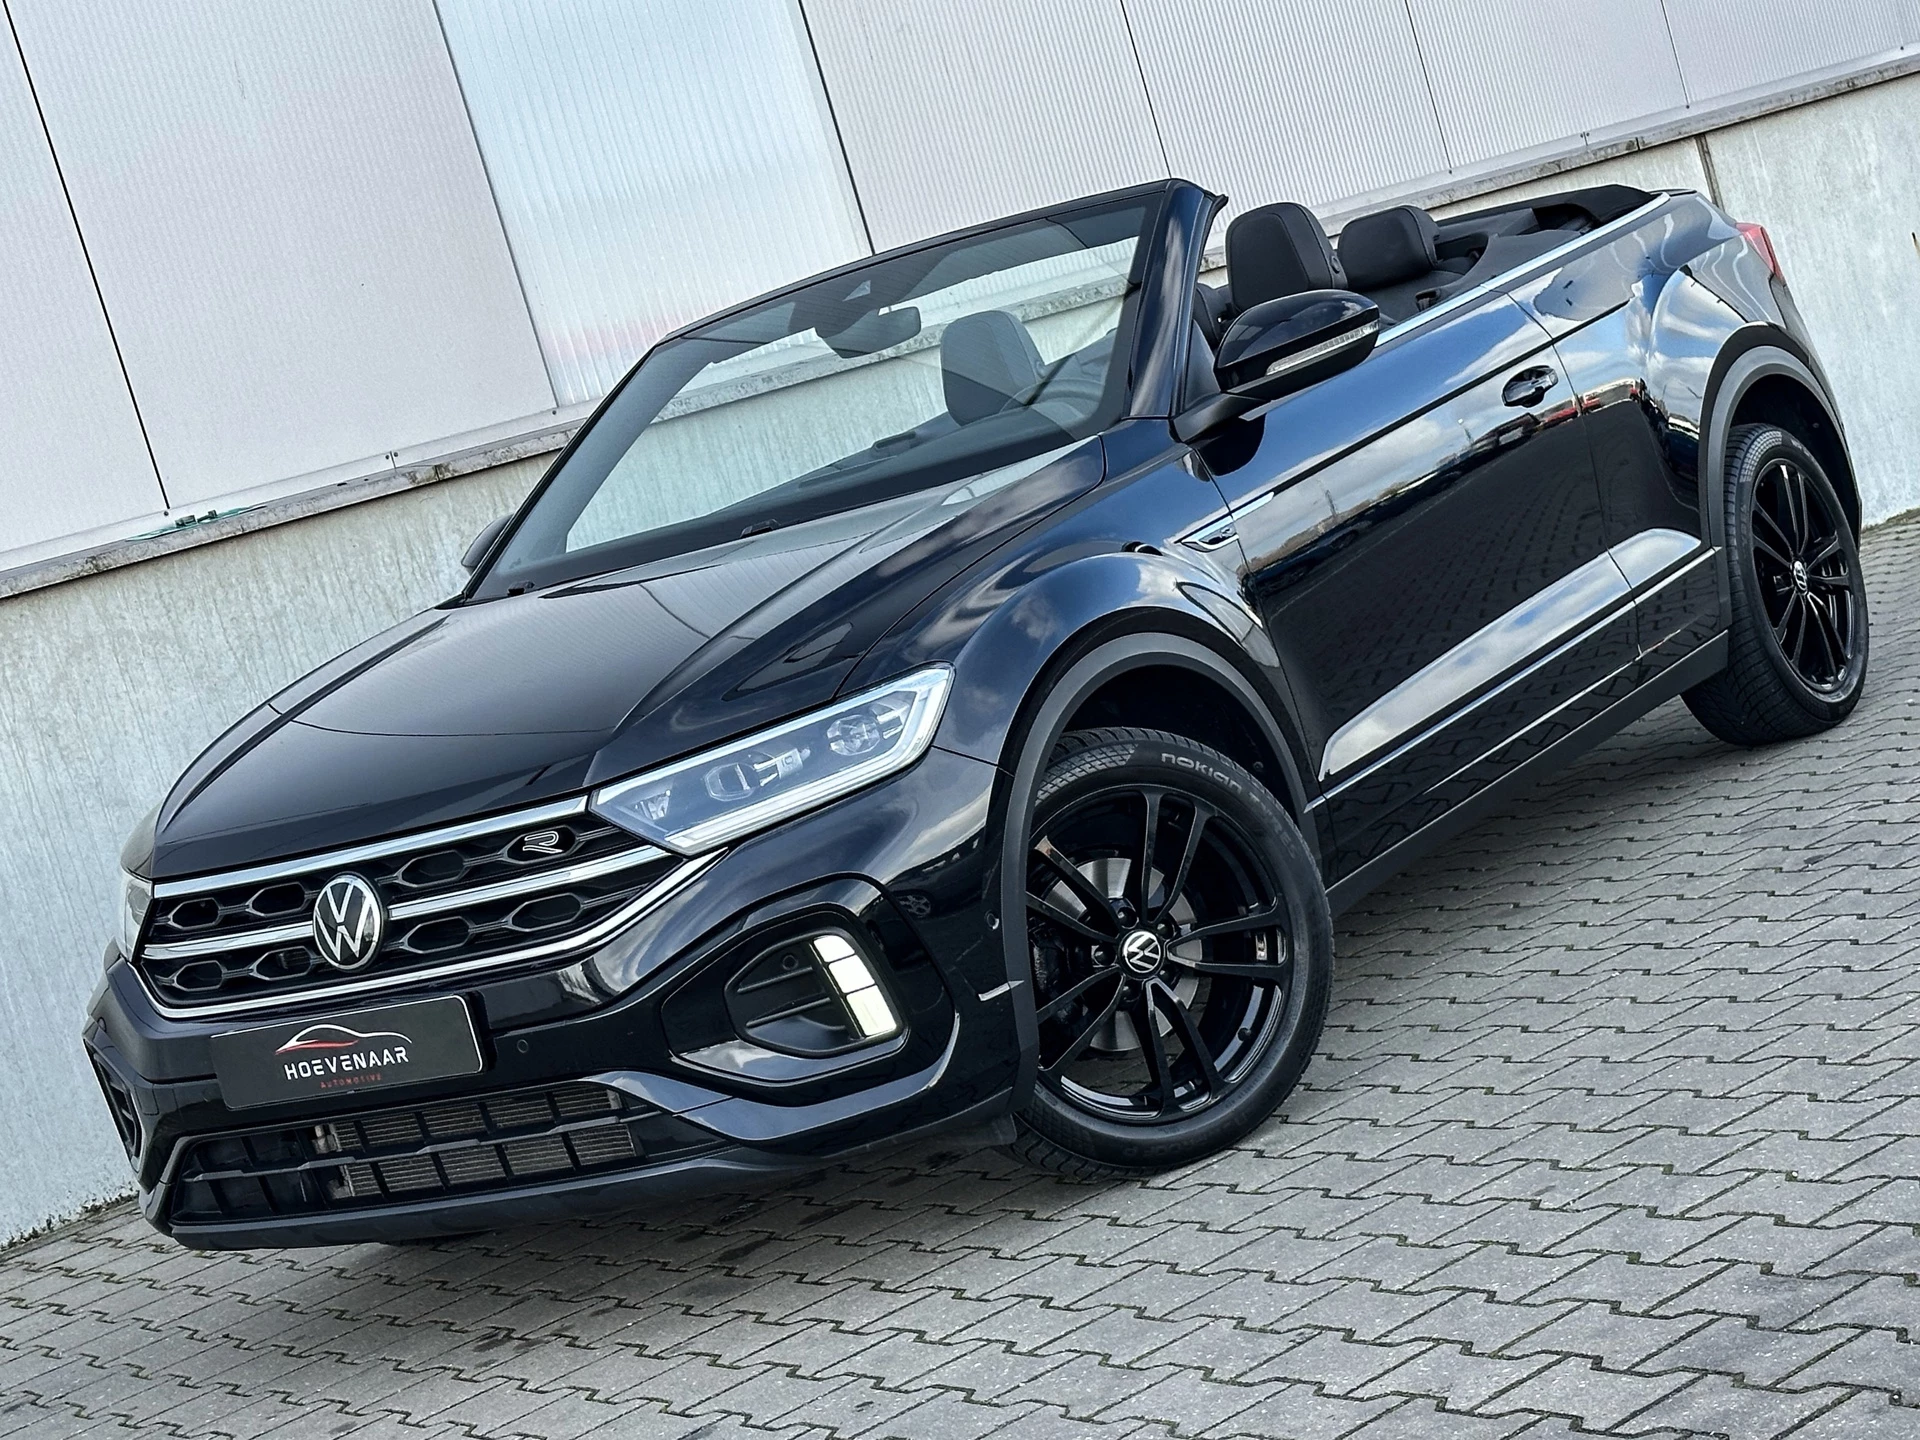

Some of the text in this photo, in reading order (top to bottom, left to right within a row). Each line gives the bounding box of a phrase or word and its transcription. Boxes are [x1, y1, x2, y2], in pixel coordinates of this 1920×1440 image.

[314, 877, 377, 965] VW
[284, 1046, 410, 1080] HOEVENAAR
[320, 1072, 382, 1089] AUTOMOTIVE
